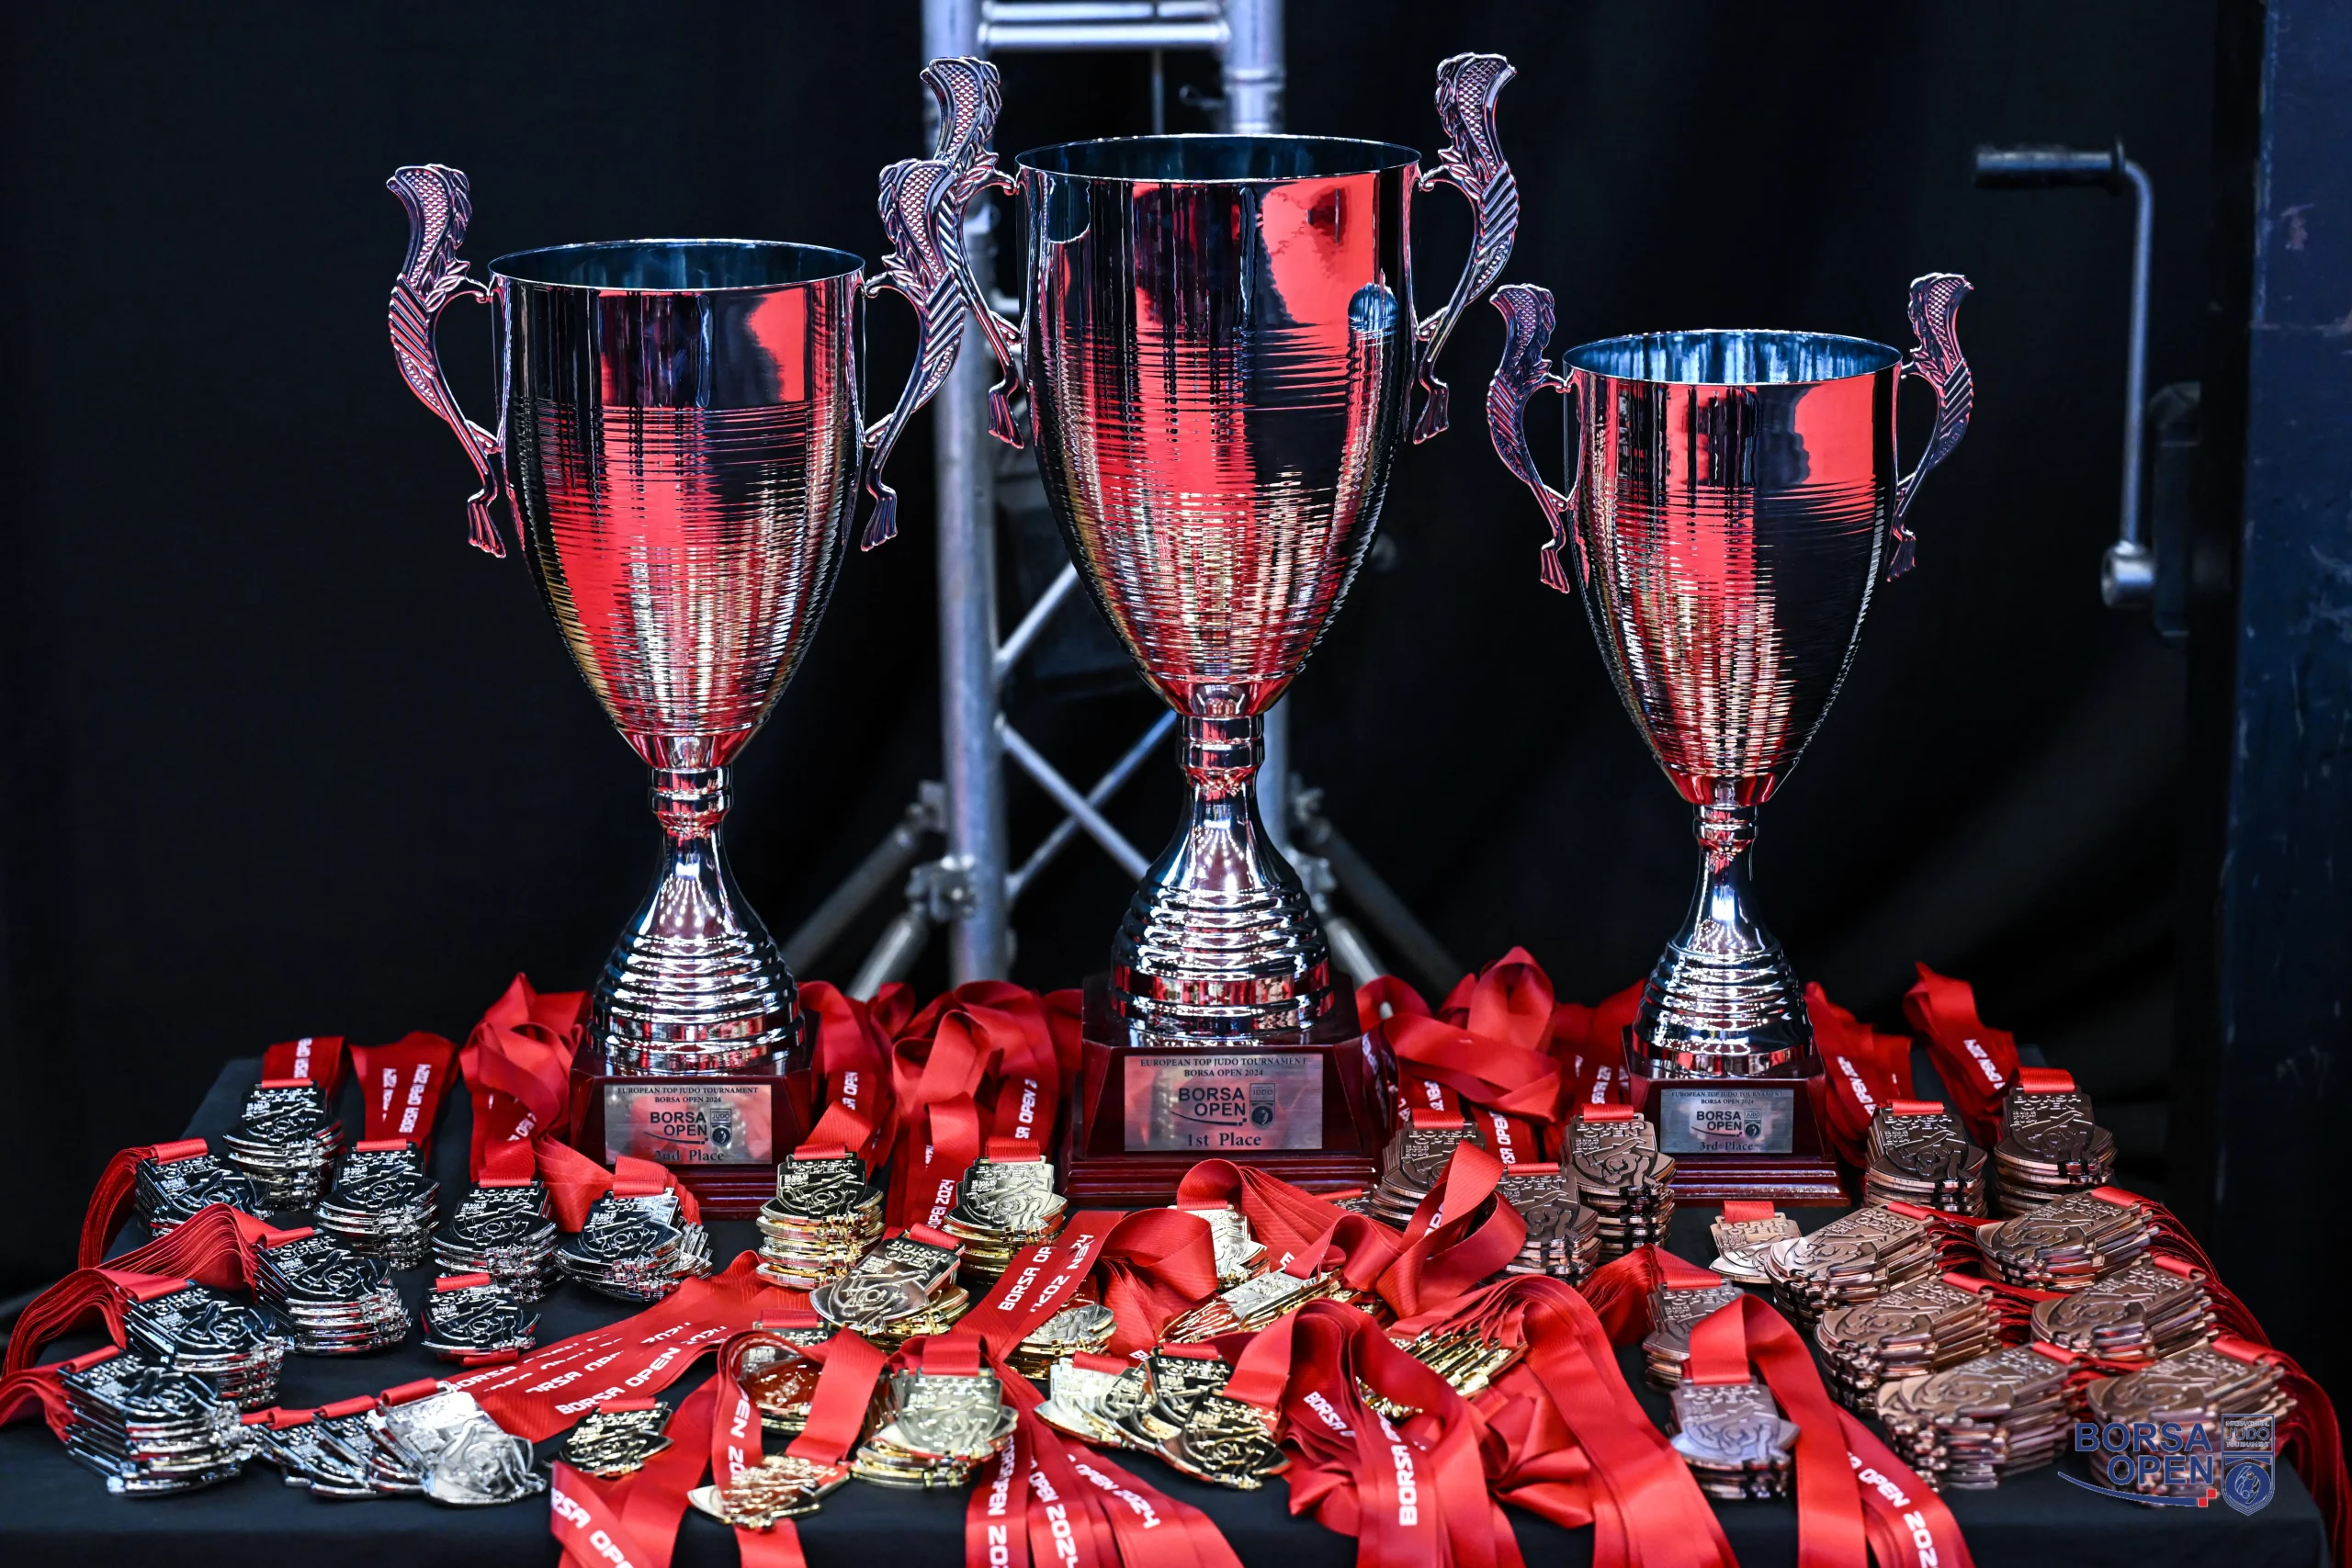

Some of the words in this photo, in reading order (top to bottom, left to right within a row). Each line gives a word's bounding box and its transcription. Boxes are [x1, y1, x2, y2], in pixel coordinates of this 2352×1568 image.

[1963, 1039, 1988, 1059] 2024
[1140, 1058, 1191, 1066] EUROPEAN
[1193, 1058, 1213, 1066] TOP
[1214, 1058, 1239, 1067] JUDO
[1240, 1057, 1307, 1066] TOURNAMENT
[1977, 1058, 2004, 1083] OPEN
[413, 1064, 431, 1085] 2024
[843, 1071, 858, 1096] OPEN
[407, 1084, 424, 1105] OPEN
[679, 1087, 702, 1095] JUDO
[1179, 1088, 1245, 1101] BORSA
[1849, 1077, 1873, 1105] OPEN
[1019, 1089, 1036, 1123] OPEN
[1194, 1102, 1246, 1116] OPEN
[1696, 1111, 1741, 1121] BORSA
[399, 1107, 419, 1134] BORSA
[650, 1111, 707, 1123] BORSA
[1577, 1122, 1645, 1131] BORSA
[1707, 1121, 1742, 1131] OPEN
[663, 1124, 707, 1136] OPEN
[1188, 1134, 1209, 1146] 1st
[1219, 1133, 1261, 1146] Place
[654, 1150, 680, 1161] 2nd
[689, 1149, 724, 1161] Place
[1699, 1141, 1718, 1151] 3rd
[1724, 1141, 1754, 1151] Place
[935, 1179, 955, 1205] 2024
[885, 1250, 938, 1269] OPEN
[887, 1240, 951, 1263] BORSA
[997, 1267, 1041, 1311] BORSA
[1033, 1246, 1052, 1263] OP
[555, 1386, 626, 1415] BORSA
[625, 1347, 682, 1387] OPEN
[1304, 1391, 1347, 1430] BORSA
[1029, 1471, 1059, 1503] OPEN
[1390, 1444, 1418, 1526] BORSA
[1113, 1489, 1160, 1529] 2024
[1858, 1468, 1911, 1507] OPEN
[1903, 1510, 1939, 1568] 202
[988, 1524, 1009, 1568] 20
